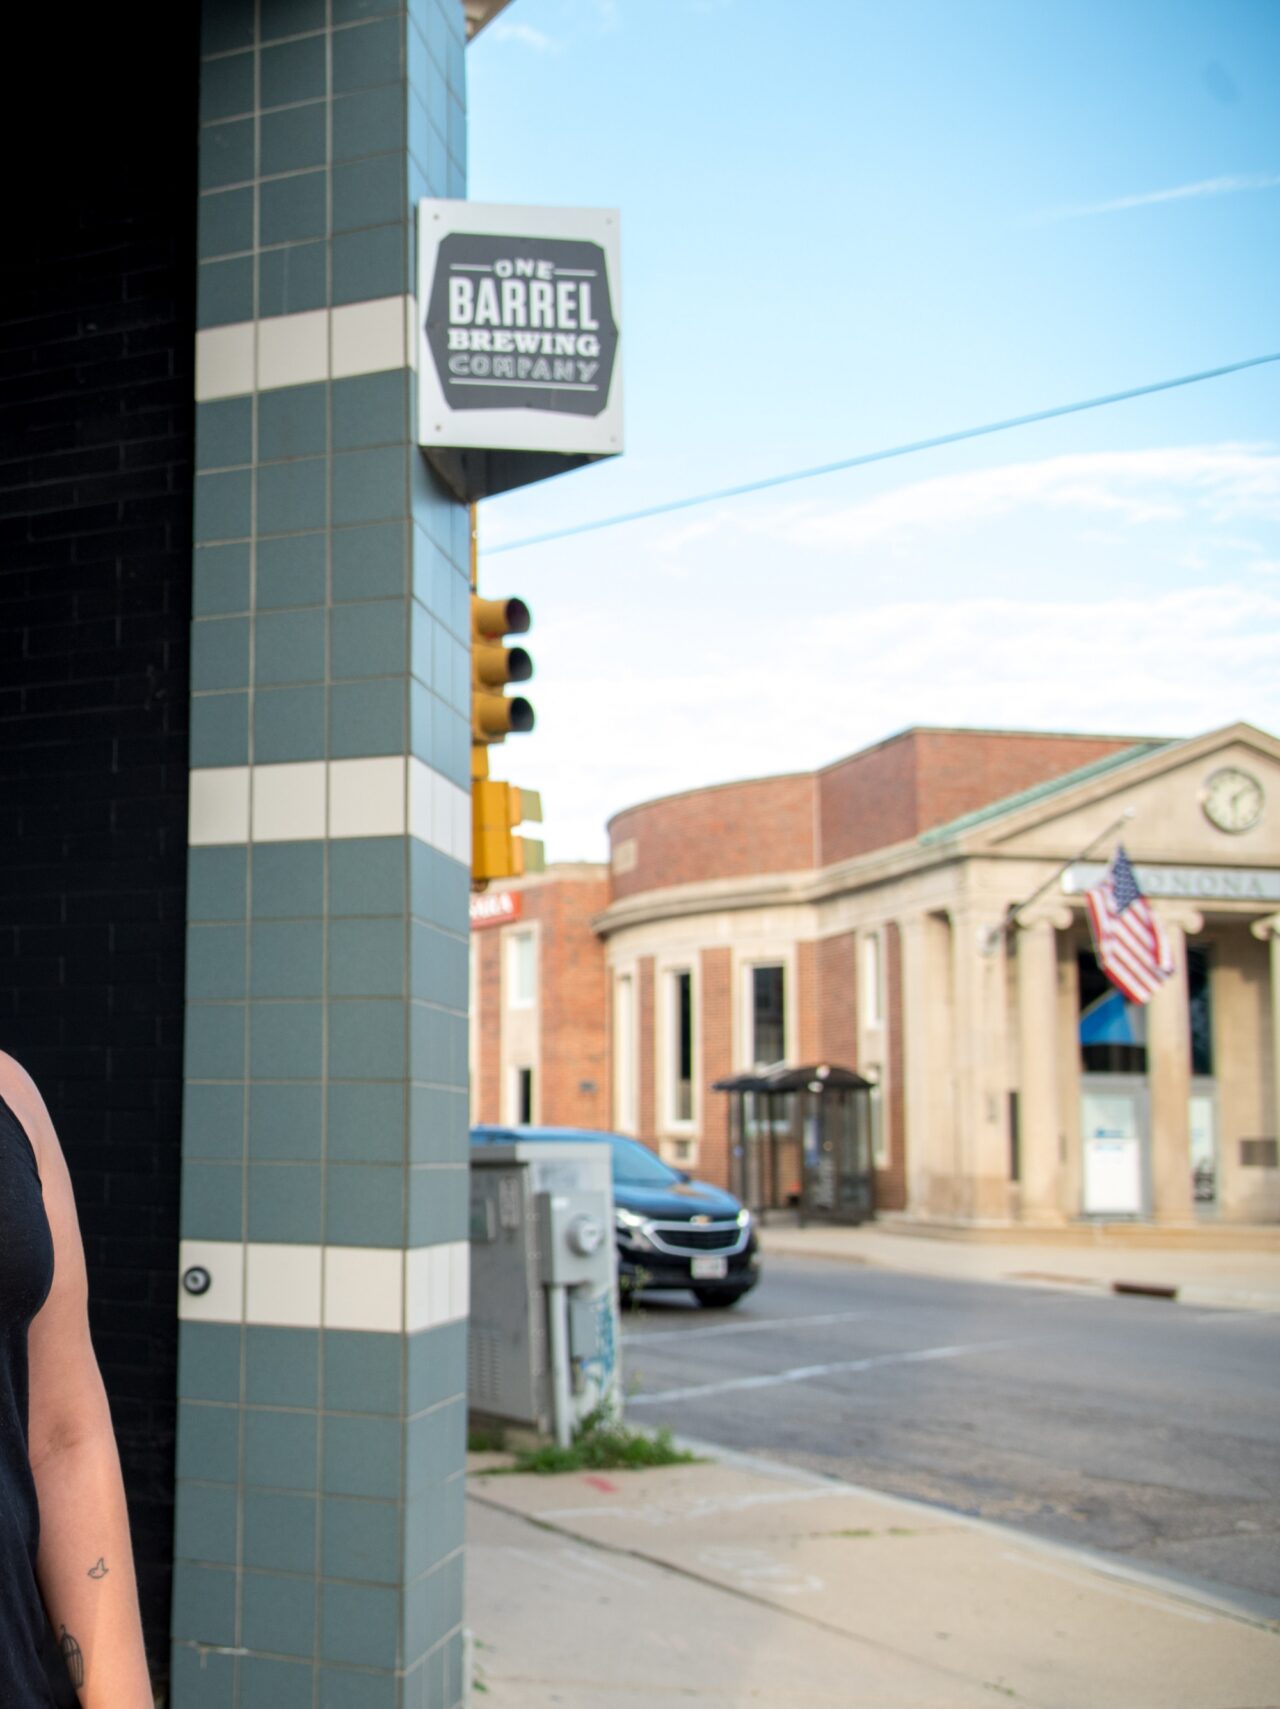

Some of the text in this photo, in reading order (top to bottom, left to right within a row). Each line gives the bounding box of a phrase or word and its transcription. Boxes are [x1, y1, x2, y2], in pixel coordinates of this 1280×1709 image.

[494, 258, 554, 281] ONE
[449, 276, 599, 330] BARREL
[448, 328, 600, 357] BREWING
[448, 353, 600, 382] COMPANY
